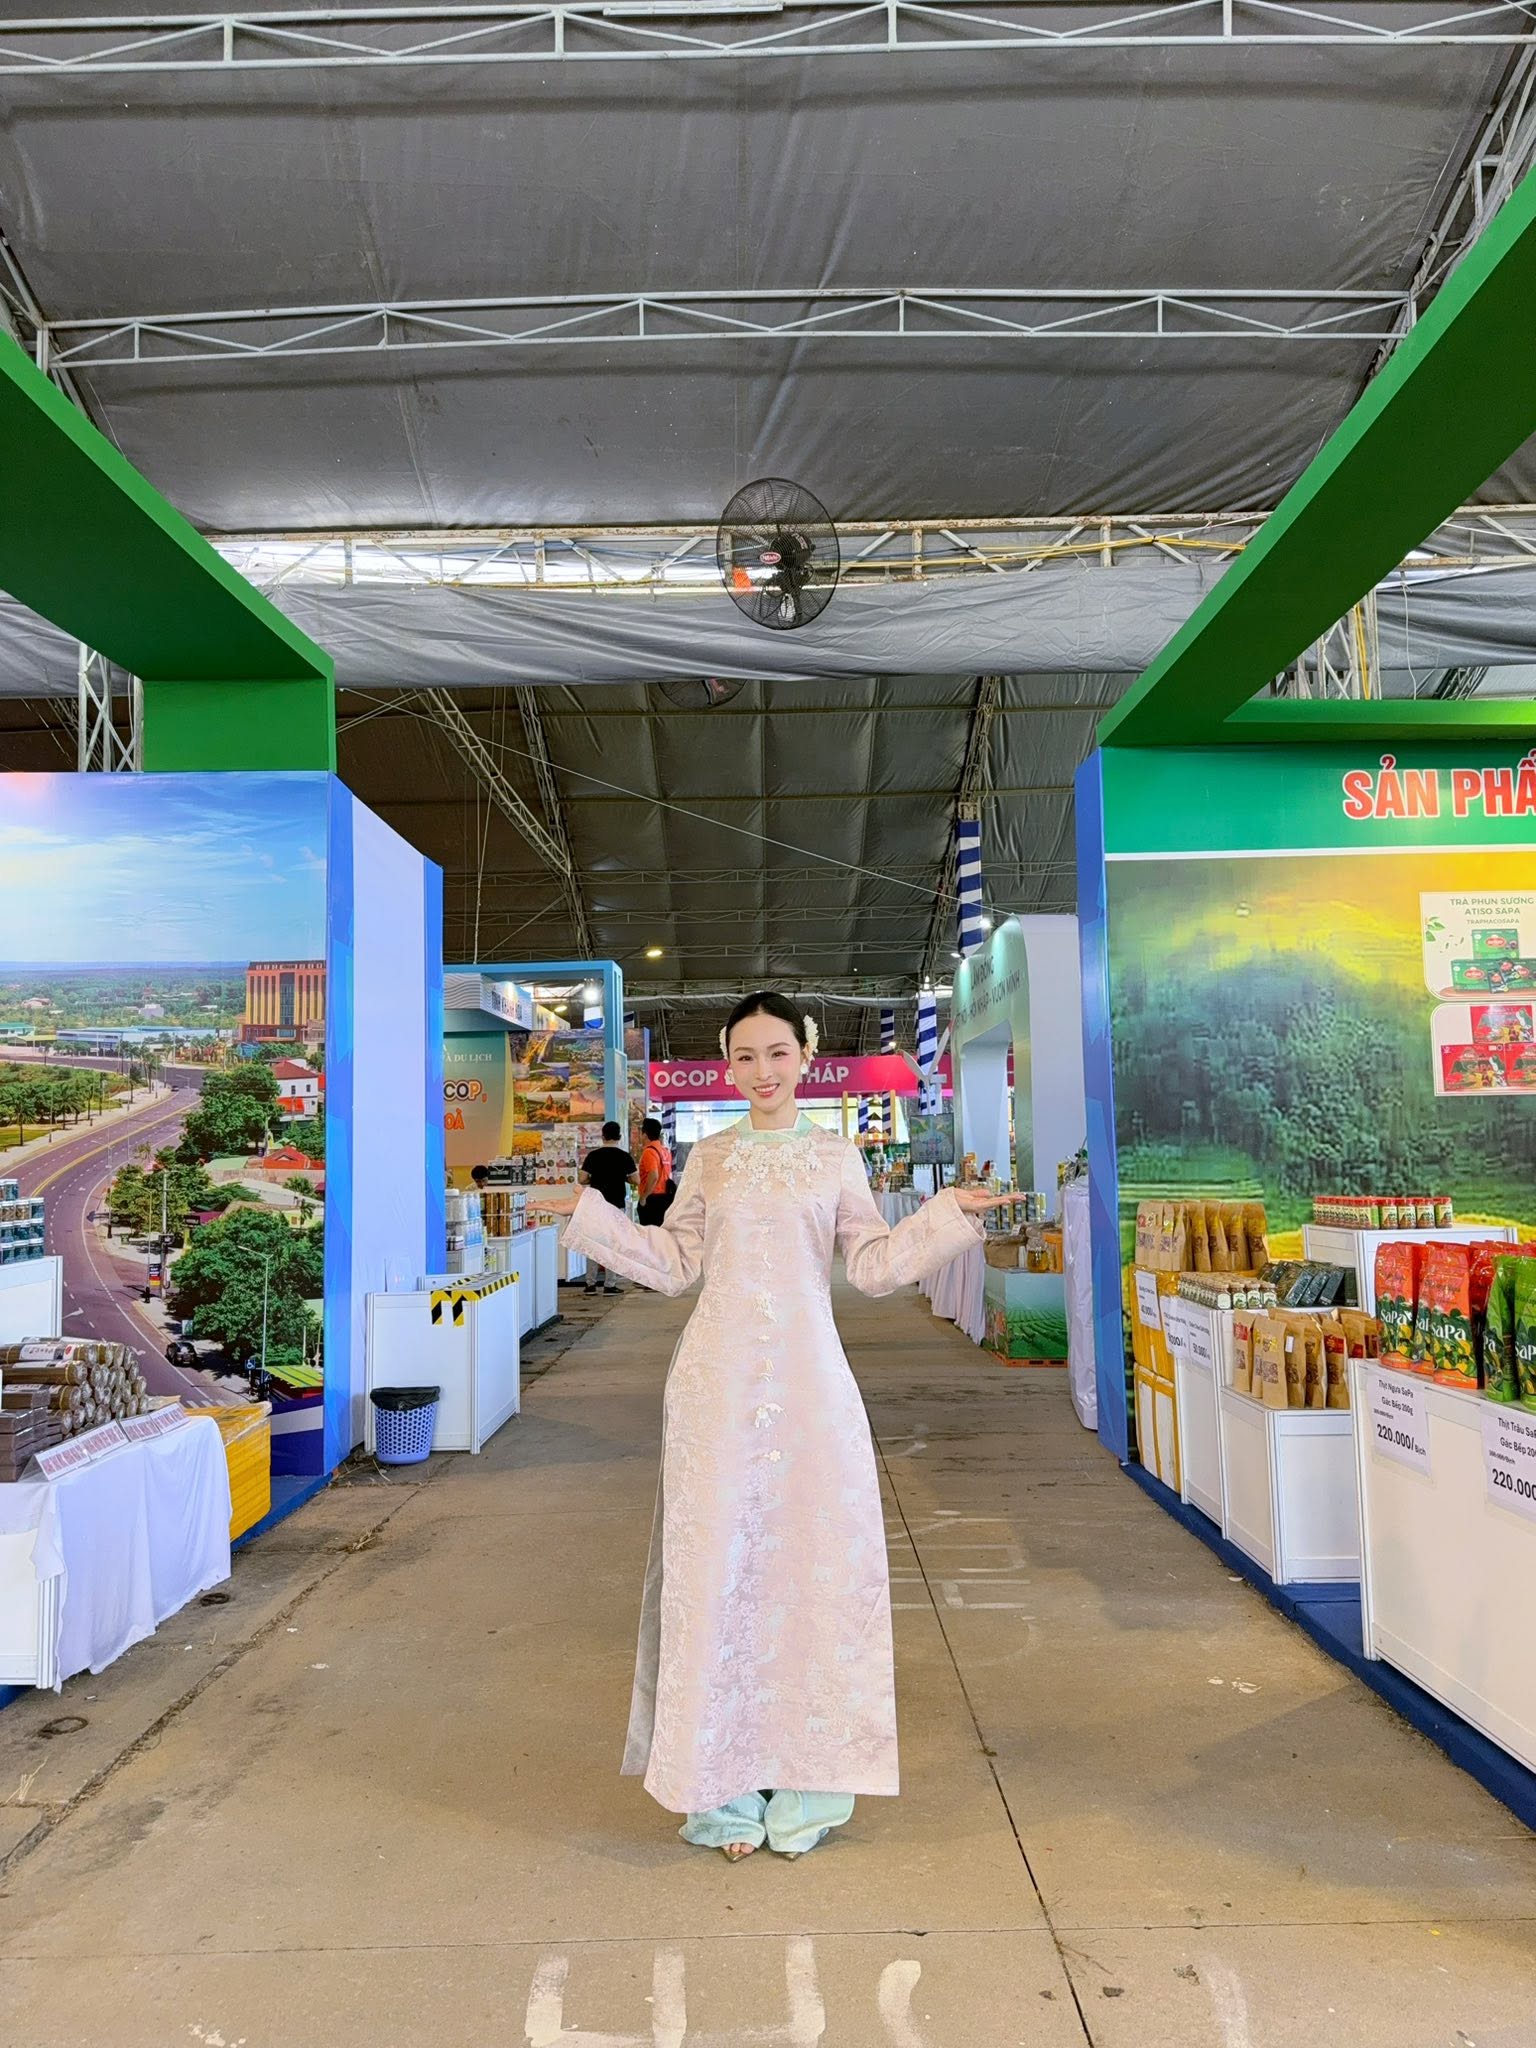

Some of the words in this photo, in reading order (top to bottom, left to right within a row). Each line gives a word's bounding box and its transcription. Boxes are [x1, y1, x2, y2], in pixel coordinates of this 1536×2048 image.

[1342, 754, 1441, 820] SẢN
[1449, 896, 1469, 906] TRÀ
[1471, 897, 1498, 906] PHUN
[1500, 897, 1534, 905] SƯƠNG
[1464, 907, 1493, 915] ATISO
[1495, 907, 1521, 915] SAPA
[454, 1054, 468, 1063] DU
[469, 1053, 493, 1064] LỊCH
[653, 1069, 719, 1088] OCOP
[1380, 1308, 1406, 1326] SaPa
[1430, 1322, 1466, 1341] SaPa
[1527, 1446, 1536, 1457] 20
